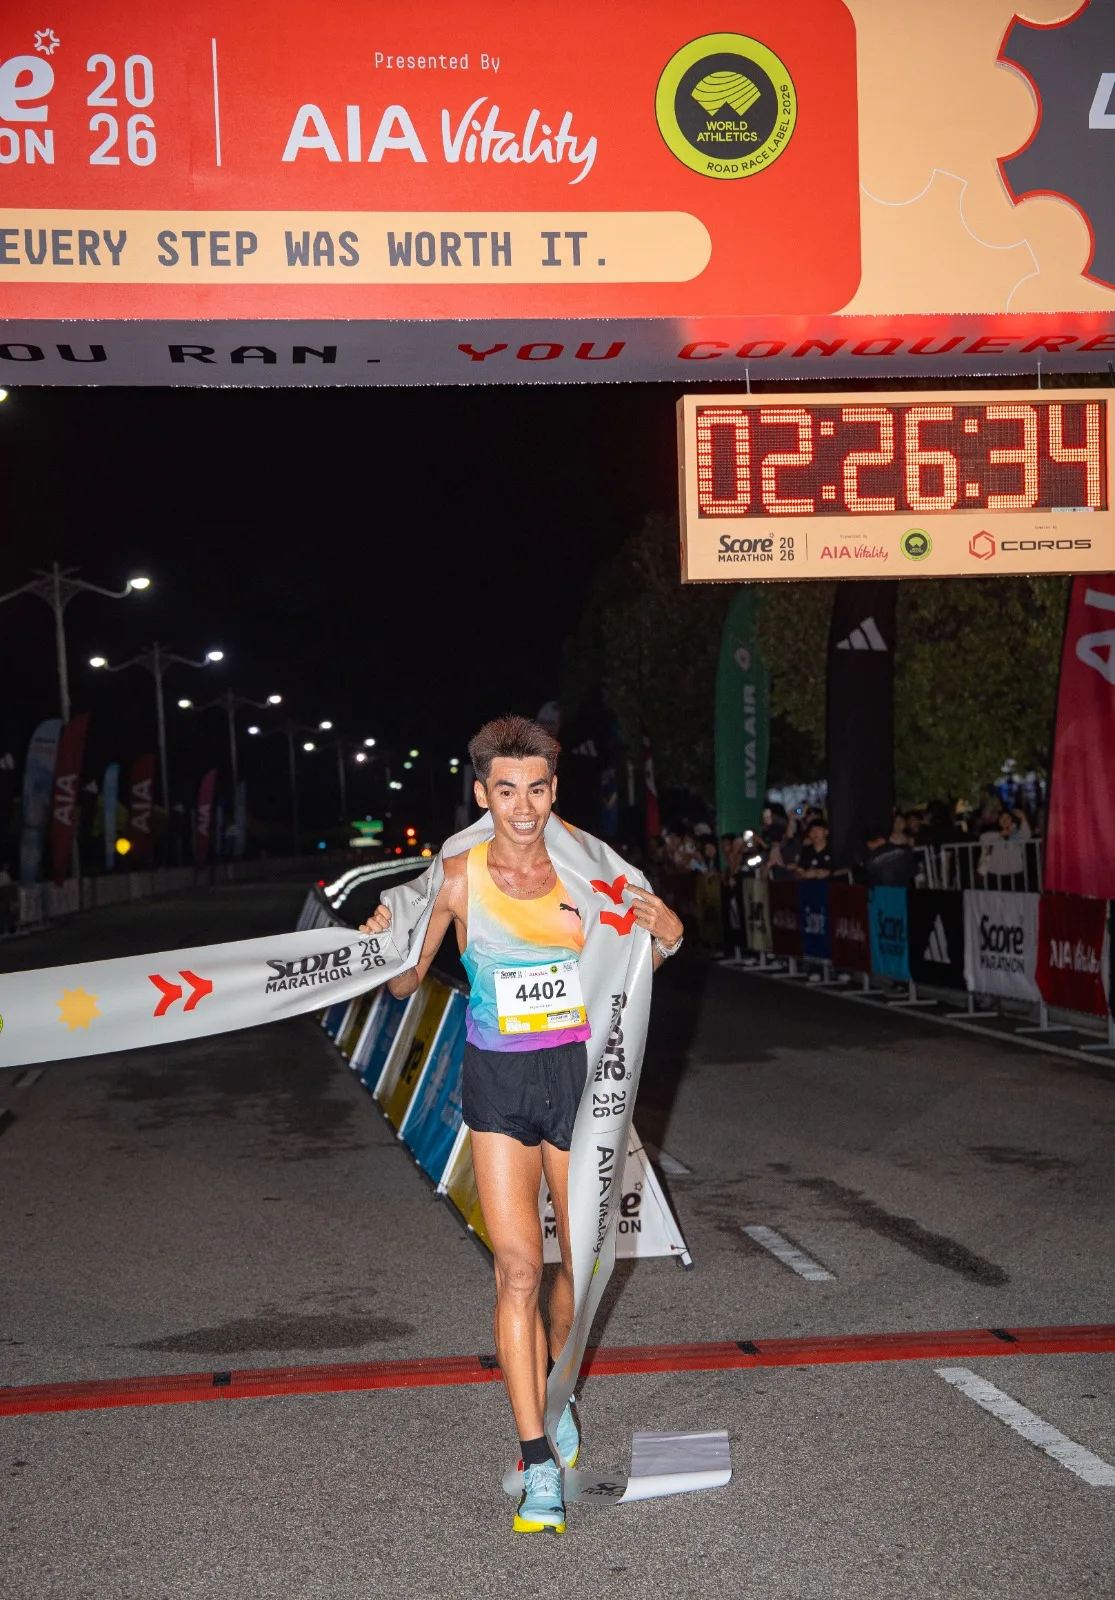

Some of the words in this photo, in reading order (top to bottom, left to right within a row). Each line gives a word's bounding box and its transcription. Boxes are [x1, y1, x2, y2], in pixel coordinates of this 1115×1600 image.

[86, 54, 155, 108] 20
[374, 52, 469, 70] Presented
[480, 53, 501, 73] By
[89, 113, 157, 167] 26
[281, 103, 428, 163] AIA
[441, 96, 598, 185] Vitality
[696, 131, 758, 142] ATHLETICS
[706, 121, 748, 131] WORLD
[707, 161, 739, 173] ROAD
[741, 150, 770, 171] RACE
[767, 118, 790, 153] LABEL
[780, 84, 791, 116] 2026
[1, 228, 128, 267] EVERY
[157, 230, 258, 267] STEP
[285, 231, 360, 268] WAS
[387, 231, 512, 268] WORTH
[541, 231, 606, 267] IT.
[456, 341, 627, 362] YOU
[697, 402, 1101, 514] 02:26:34
[718, 534, 774, 553] Score
[779, 537, 794, 549] 20
[718, 553, 774, 563] MARATHON
[780, 549, 795, 562] 26
[820, 545, 852, 560] AIA
[853, 543, 889, 562] Vitality
[1001, 539, 1092, 551] COROS
[743, 739, 757, 800] EVA
[54, 773, 79, 826] AIA
[130, 778, 153, 834] AIA
[980, 914, 1024, 955] Score
[264, 967, 353, 994] MARATHON
[361, 954, 386, 973] 26
[265, 945, 352, 982] Score
[360, 937, 381, 957] 20
[515, 979, 567, 1003] 4402
[592, 1093, 610, 1119] 26
[611, 1090, 627, 1116] 20
[596, 1145, 615, 1196] AIA
